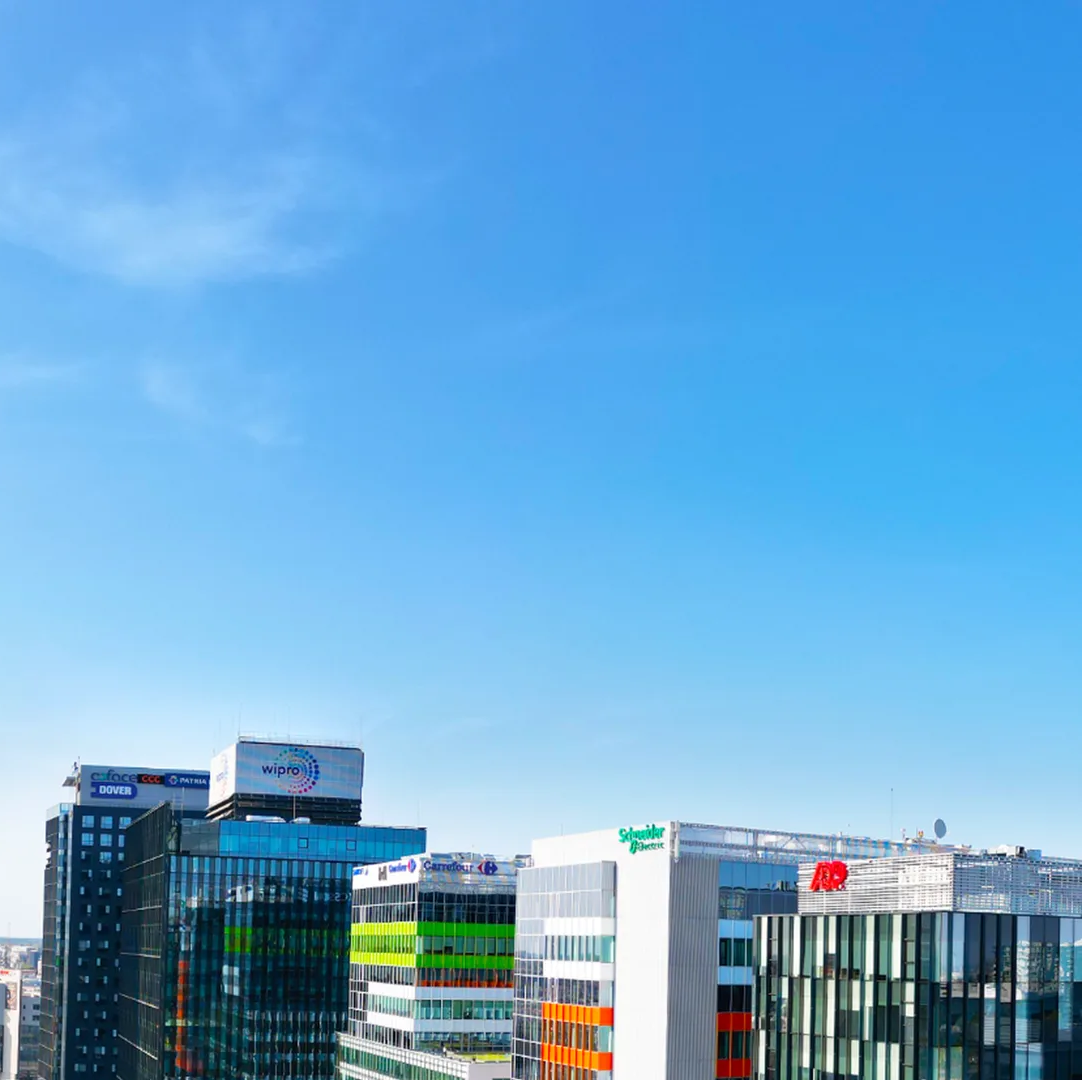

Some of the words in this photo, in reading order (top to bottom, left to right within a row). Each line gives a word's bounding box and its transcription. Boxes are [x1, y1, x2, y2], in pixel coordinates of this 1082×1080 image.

[90, 769, 137, 782] coface
[262, 763, 300, 778] wipro
[141, 775, 161, 783] CCC
[179, 777, 207, 785] PATRIA
[99, 785, 132, 795] DOVER
[423, 860, 474, 873] Carrefour
